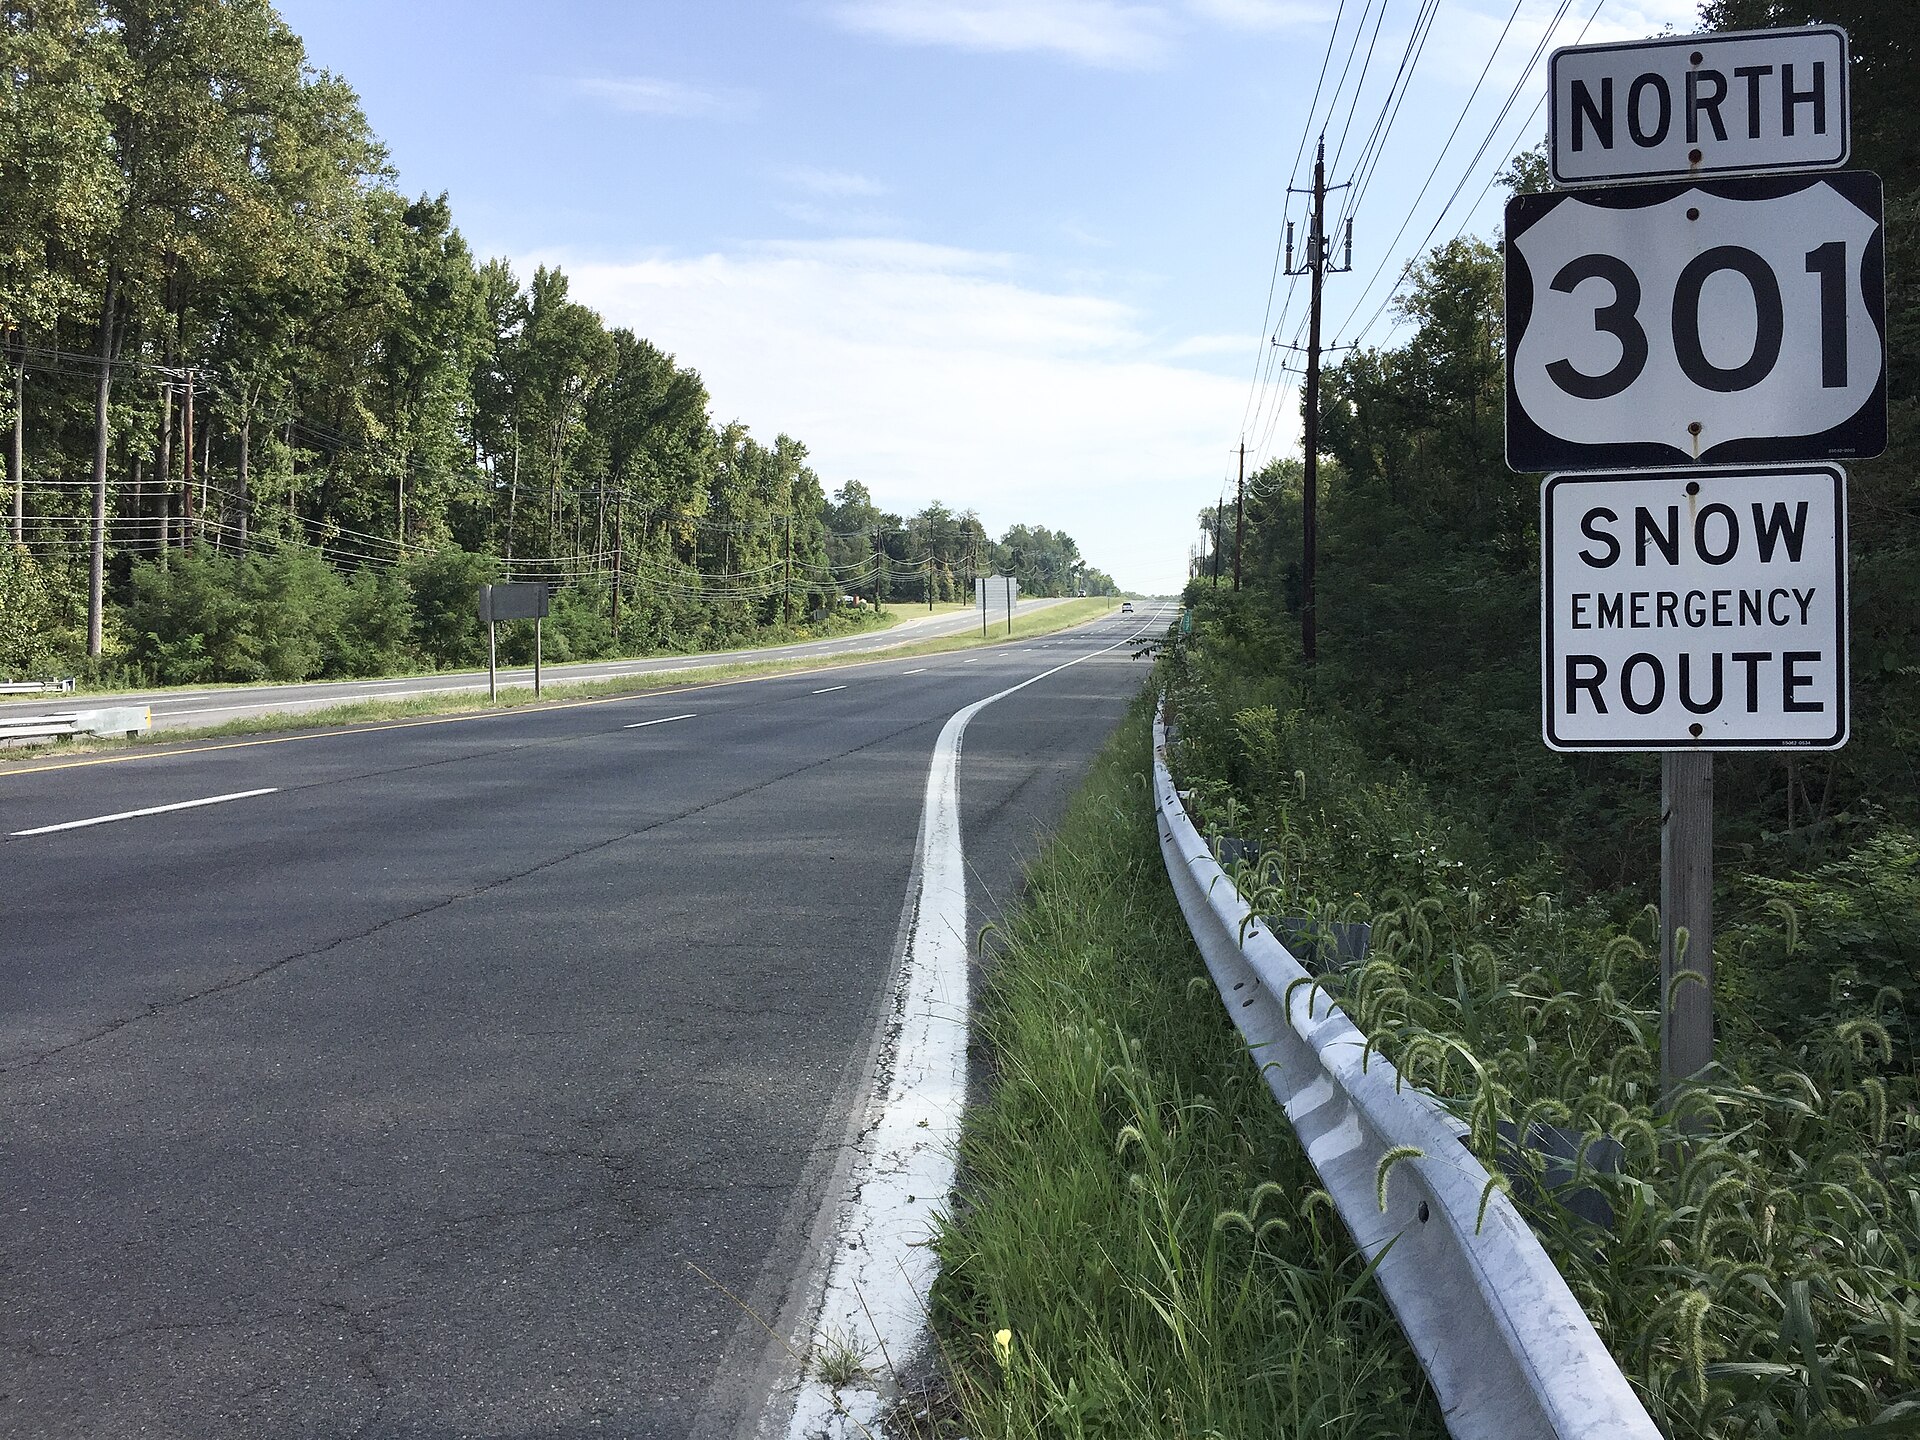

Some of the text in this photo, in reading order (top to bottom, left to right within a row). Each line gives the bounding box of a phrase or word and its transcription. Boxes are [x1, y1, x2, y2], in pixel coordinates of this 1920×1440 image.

[1571, 61, 1826, 152] NORTH
[1544, 241, 1848, 400] 301
[1578, 501, 1809, 569] SNOW
[1571, 588, 1816, 629] EMERGENCY
[1566, 651, 1824, 715] ROUTE
